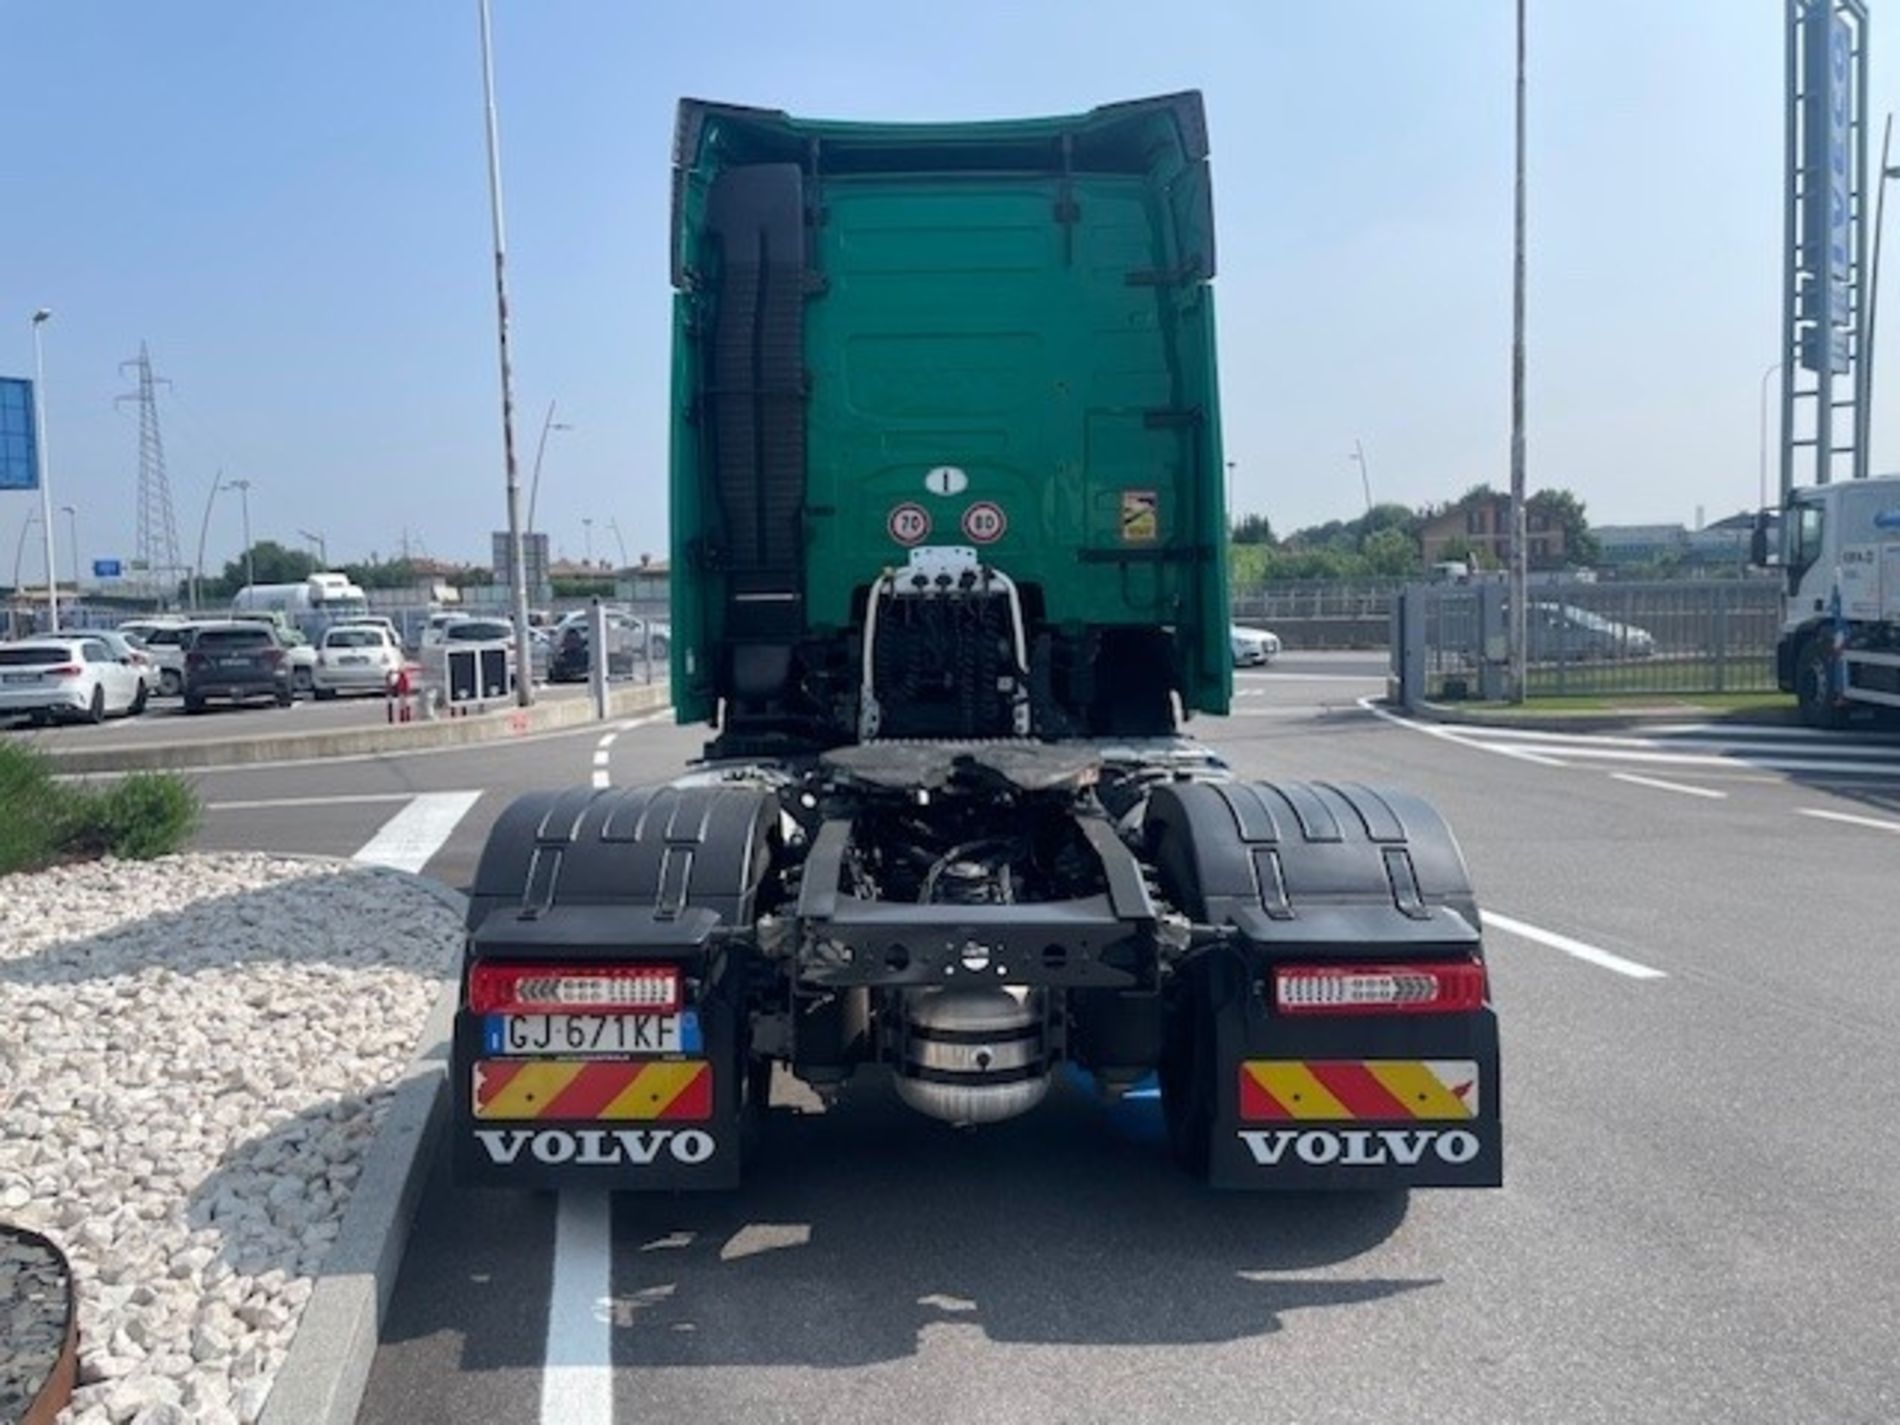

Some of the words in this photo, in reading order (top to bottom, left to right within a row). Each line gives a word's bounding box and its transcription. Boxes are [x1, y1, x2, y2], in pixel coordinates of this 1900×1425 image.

[901, 515, 920, 532] 70
[974, 515, 995, 530] 80
[474, 1130, 715, 1163] VOLVO
[1238, 1130, 1480, 1164] VOLVO
